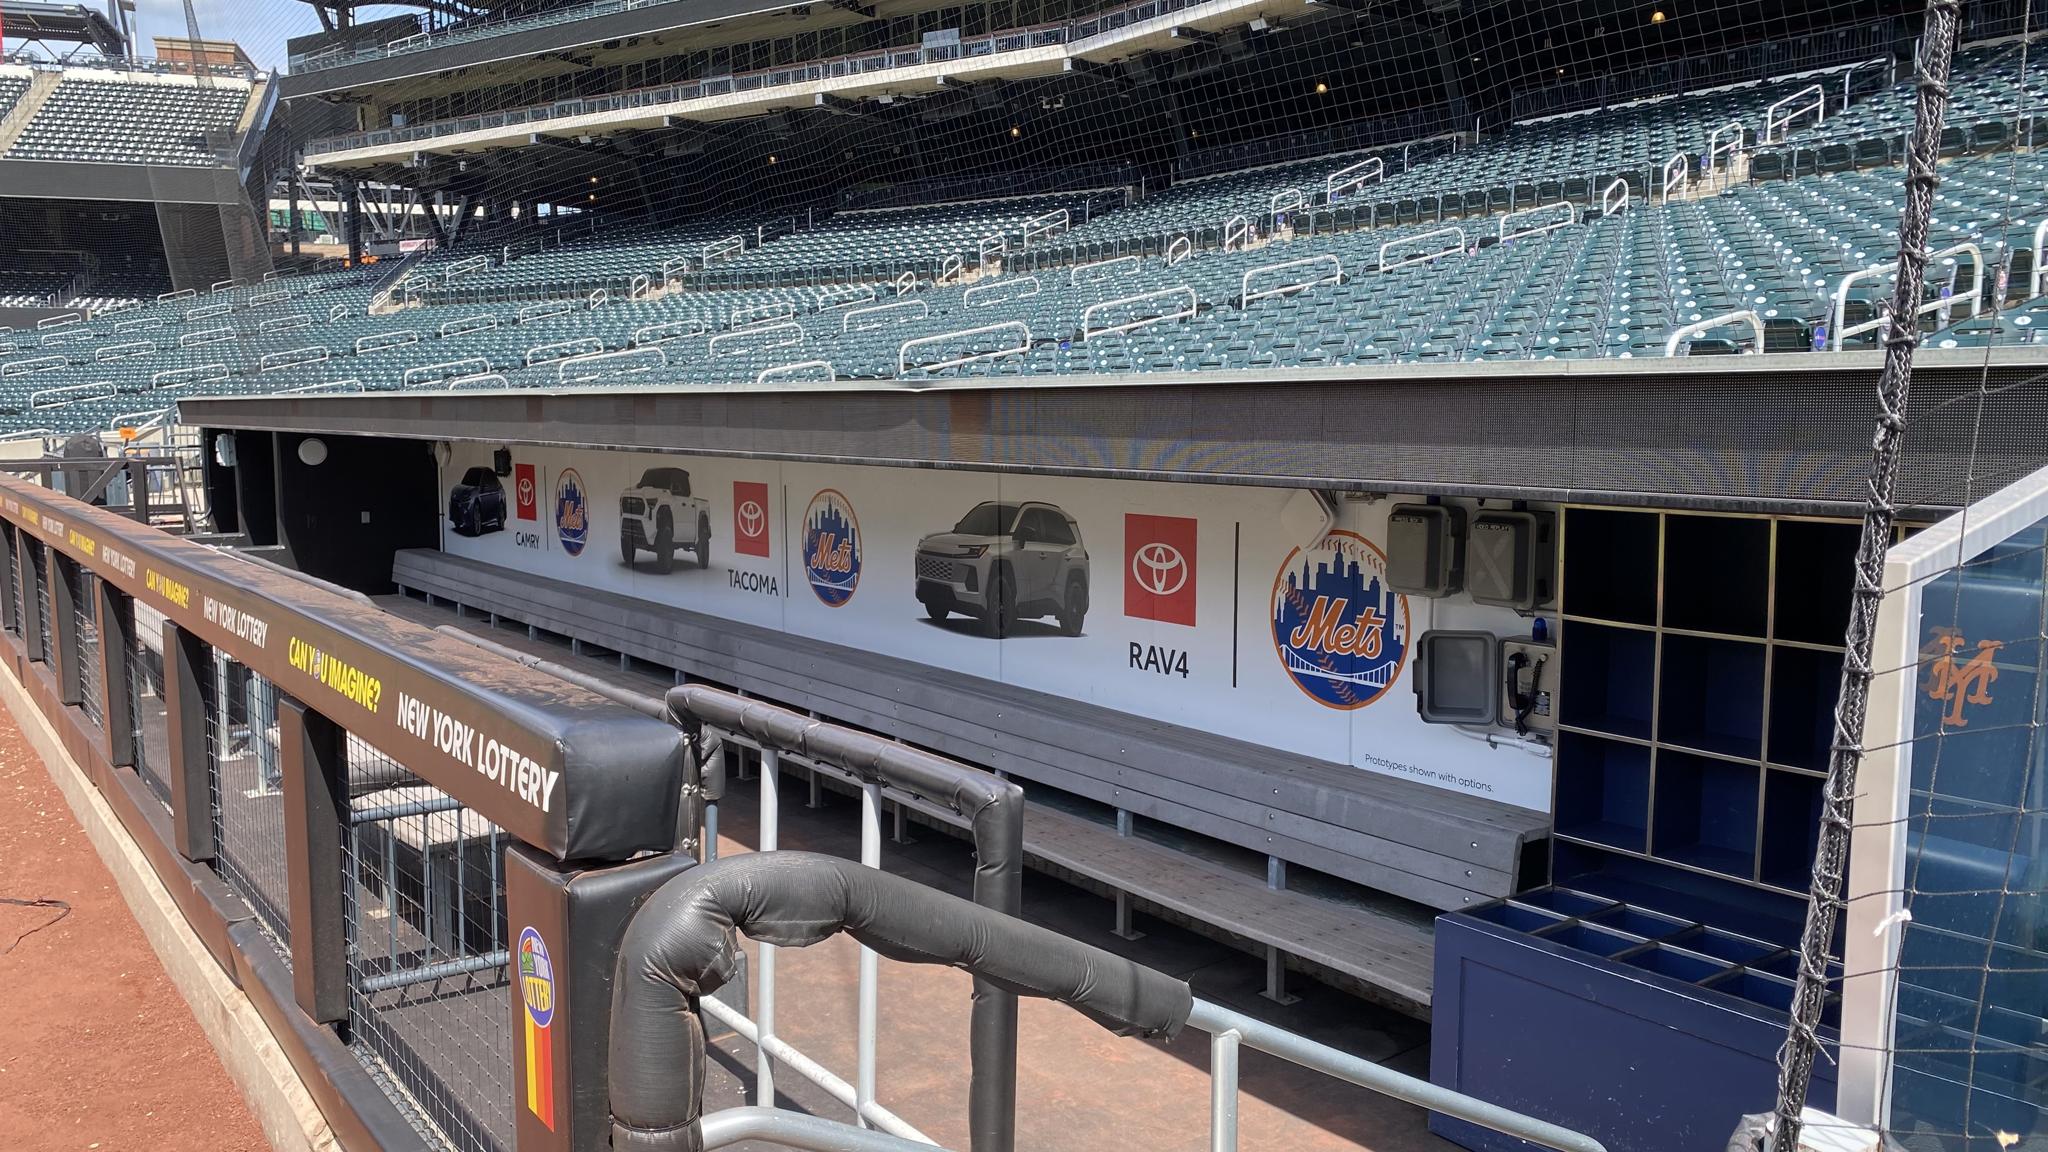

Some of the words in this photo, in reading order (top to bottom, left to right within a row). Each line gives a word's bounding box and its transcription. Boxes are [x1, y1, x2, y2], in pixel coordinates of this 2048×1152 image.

[560, 500, 584, 530] Mets
[515, 532, 540, 550] CAMRY
[811, 532, 852, 573] Mets
[727, 569, 779, 597] TACOMA
[203, 595, 219, 624] NEW
[218, 601, 237, 634] YORK
[236, 610, 268, 649] LOTTERY
[1290, 595, 1386, 660] Mets
[288, 636, 307, 673] CAN
[328, 656, 381, 714] IMAGINE?
[1129, 641, 1190, 679] RAV4
[396, 691, 431, 740] NEW
[432, 709, 475, 768] YORK
[476, 733, 560, 813] LOTTERY
[1365, 753, 1408, 771] Prototypes
[1408, 764, 1437, 780] shown
[1438, 772, 1457, 783] with
[1458, 778, 1495, 793] options.
